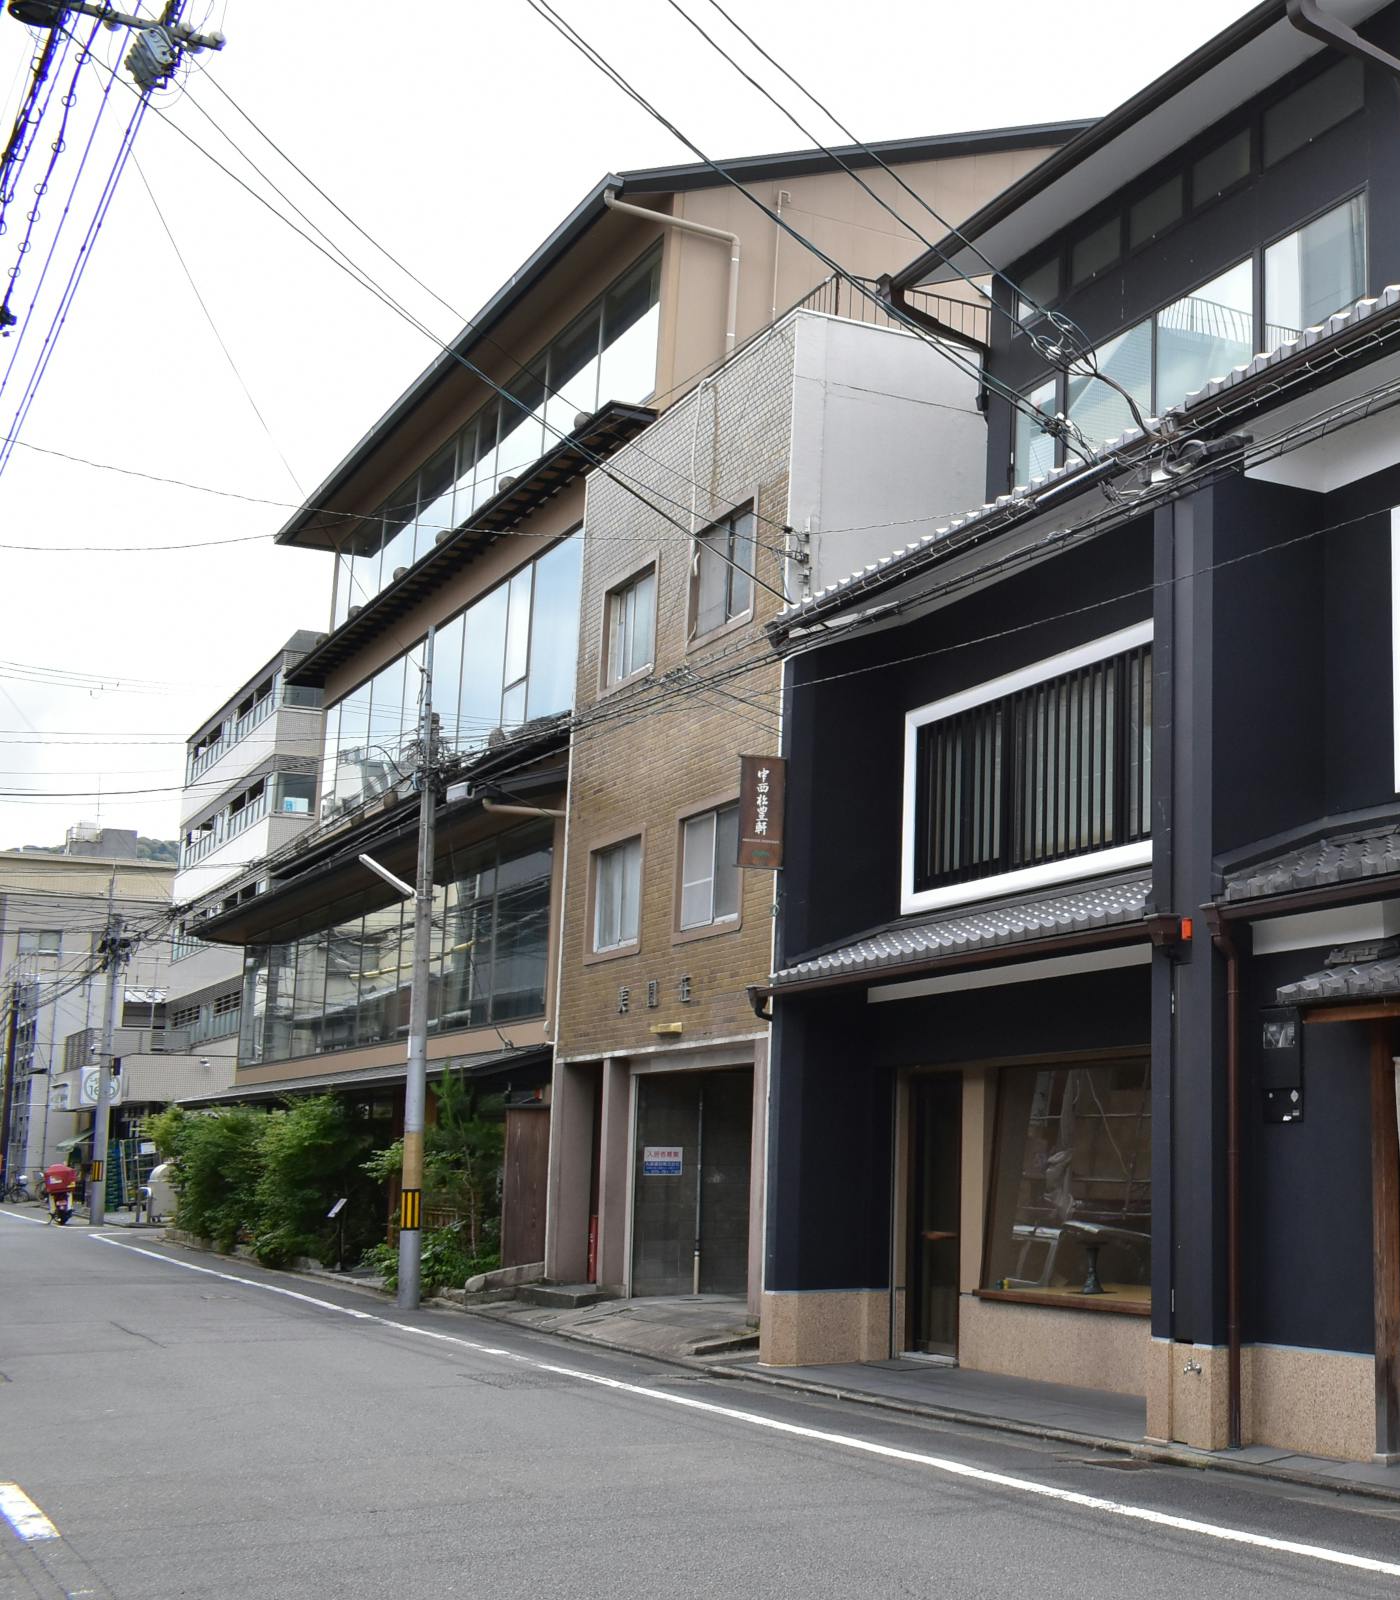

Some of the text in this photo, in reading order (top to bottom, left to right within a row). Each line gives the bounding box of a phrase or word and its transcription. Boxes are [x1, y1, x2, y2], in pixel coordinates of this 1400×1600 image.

[754, 768, 770, 836] 中西松豊軒
